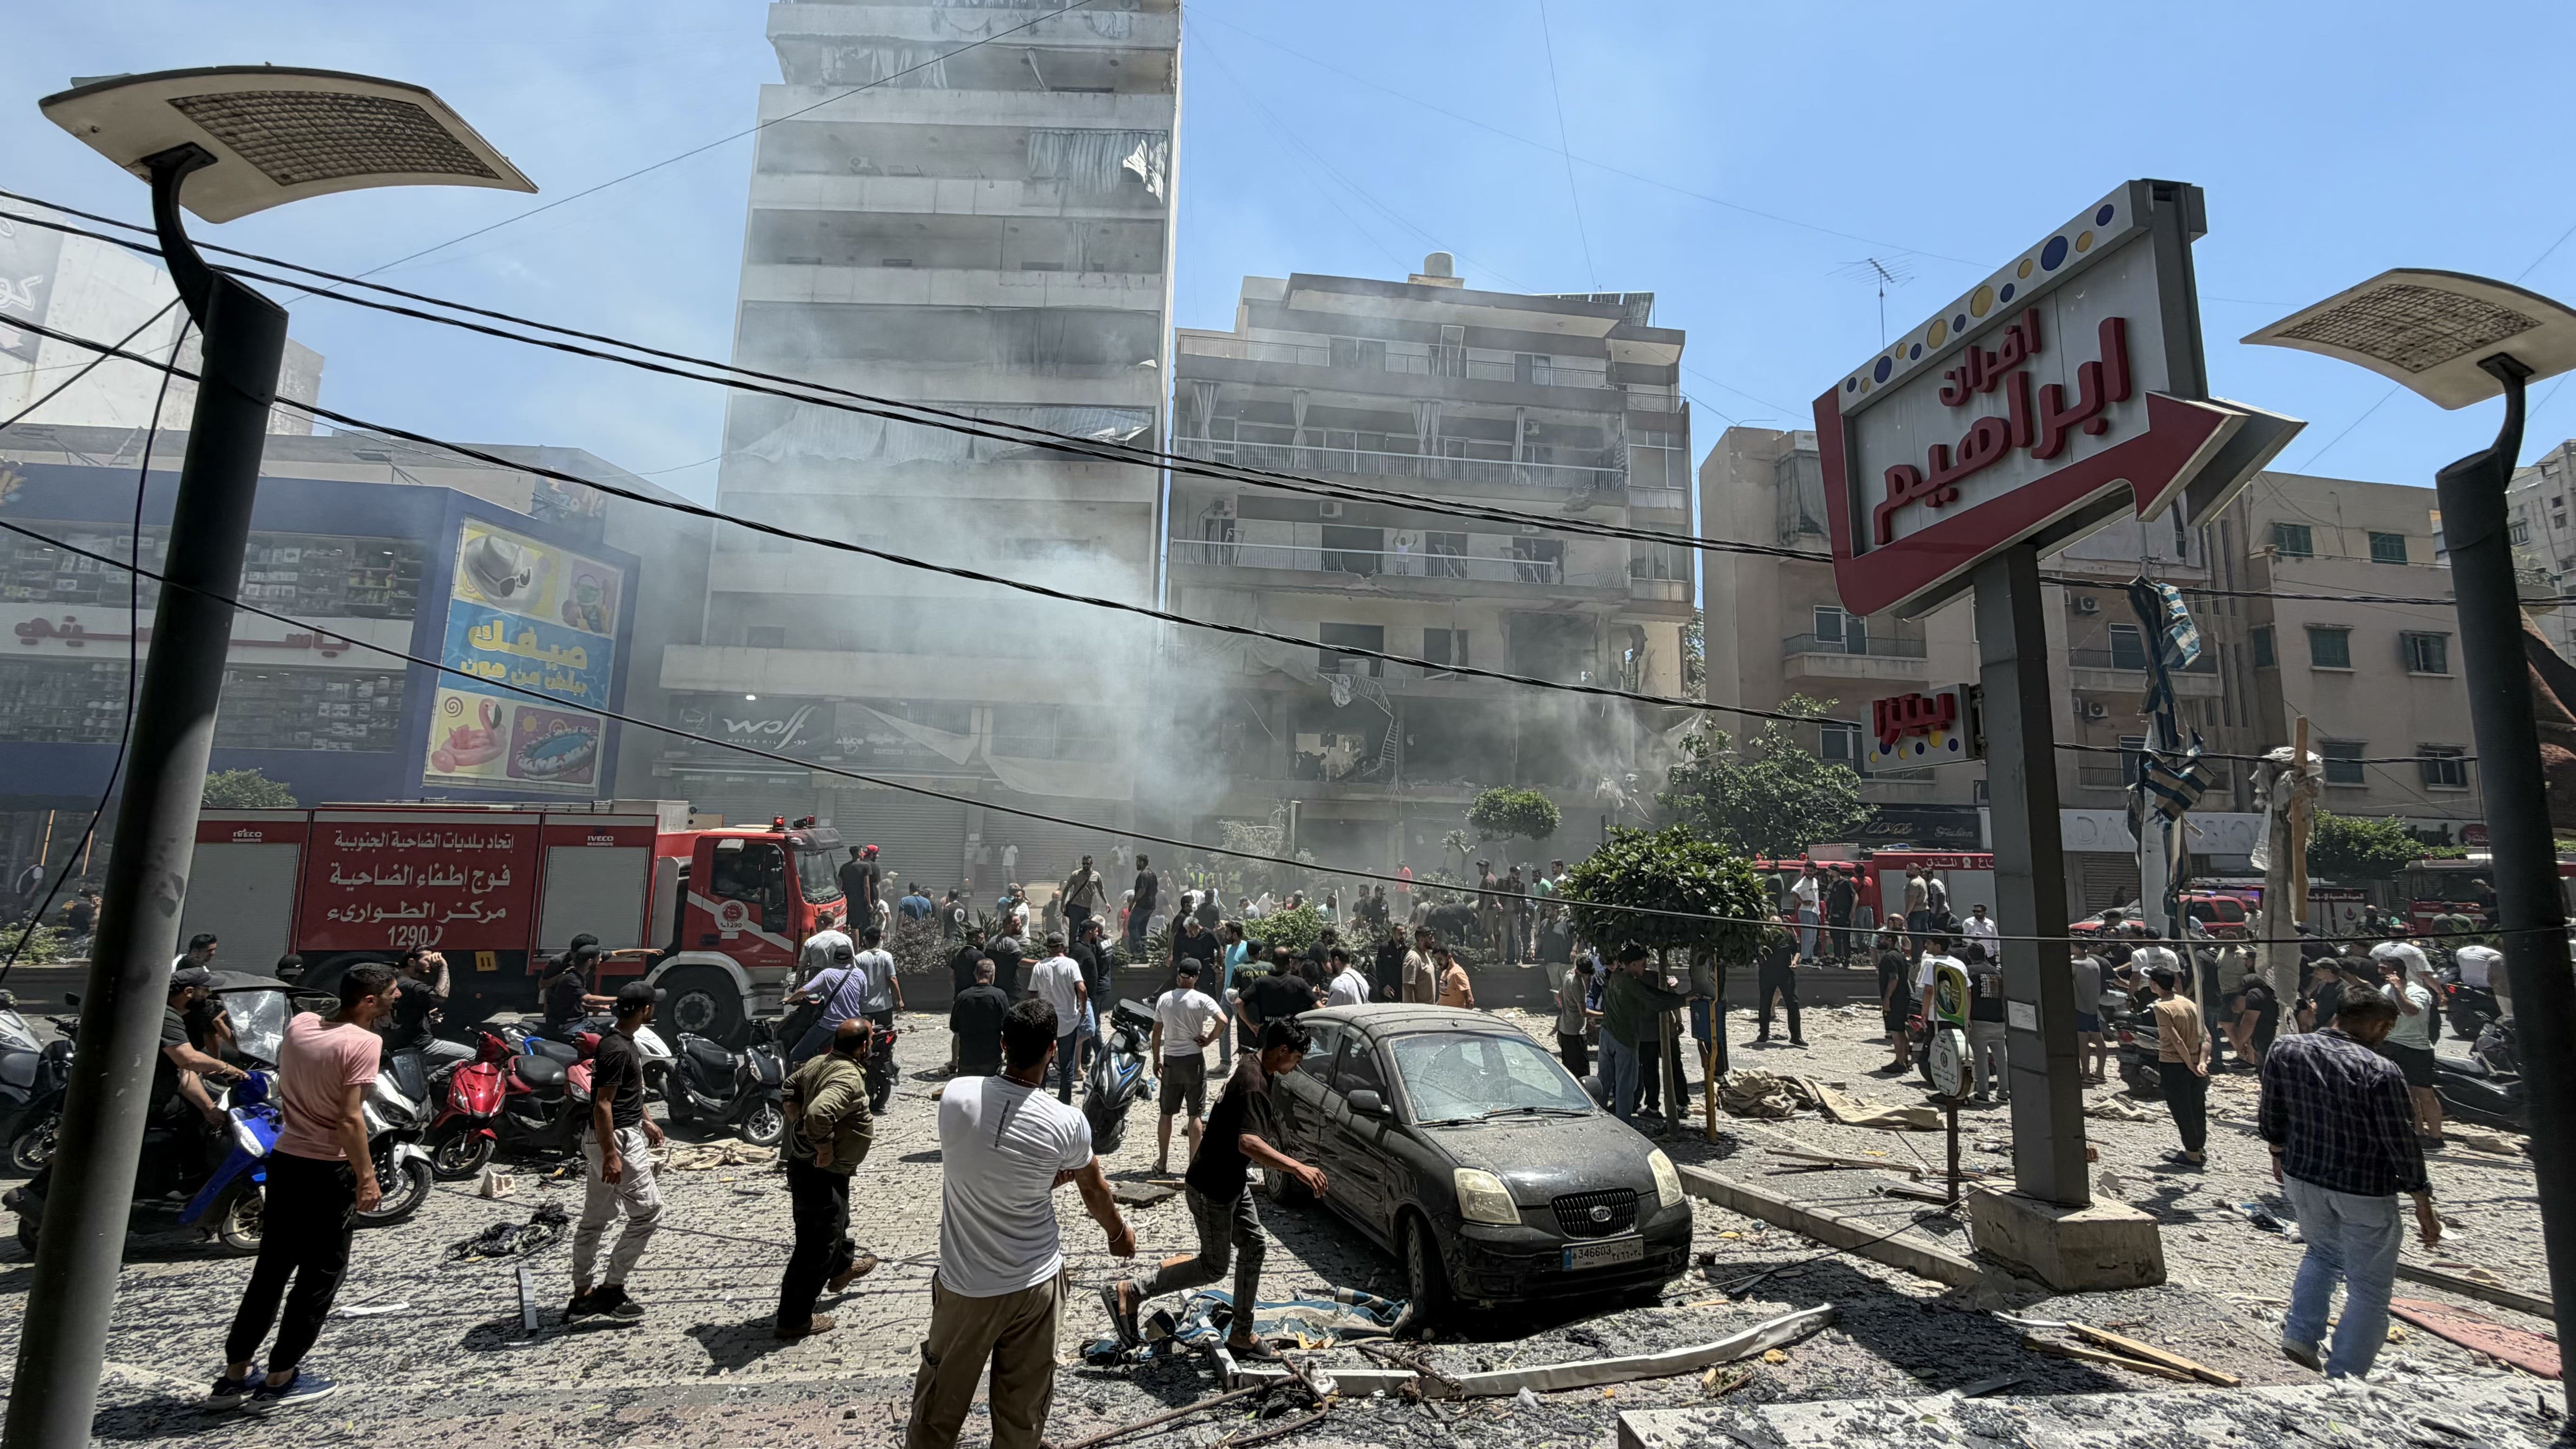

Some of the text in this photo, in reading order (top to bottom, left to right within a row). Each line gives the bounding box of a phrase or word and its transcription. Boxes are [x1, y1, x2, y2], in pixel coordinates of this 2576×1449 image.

[1939, 308, 2042, 407] افران
[1873, 317, 2132, 546] ابراهيم
[468, 619, 588, 670] صيفك
[461, 657, 507, 678] هون
[511, 667, 540, 685] من
[1872, 693, 1955, 745] بيتزا
[334, 830, 514, 853] إتحاد بلديات الضاحية الجنوبية
[1934, 826, 1974, 837] Fashion
[329, 862, 511, 894] فوج إطفاء الضاحية
[436, 900, 507, 923] مركز
[388, 925, 428, 947] 1290
[1594, 1210, 1608, 1219] KIA
[1578, 1245, 1611, 1258] 346603
